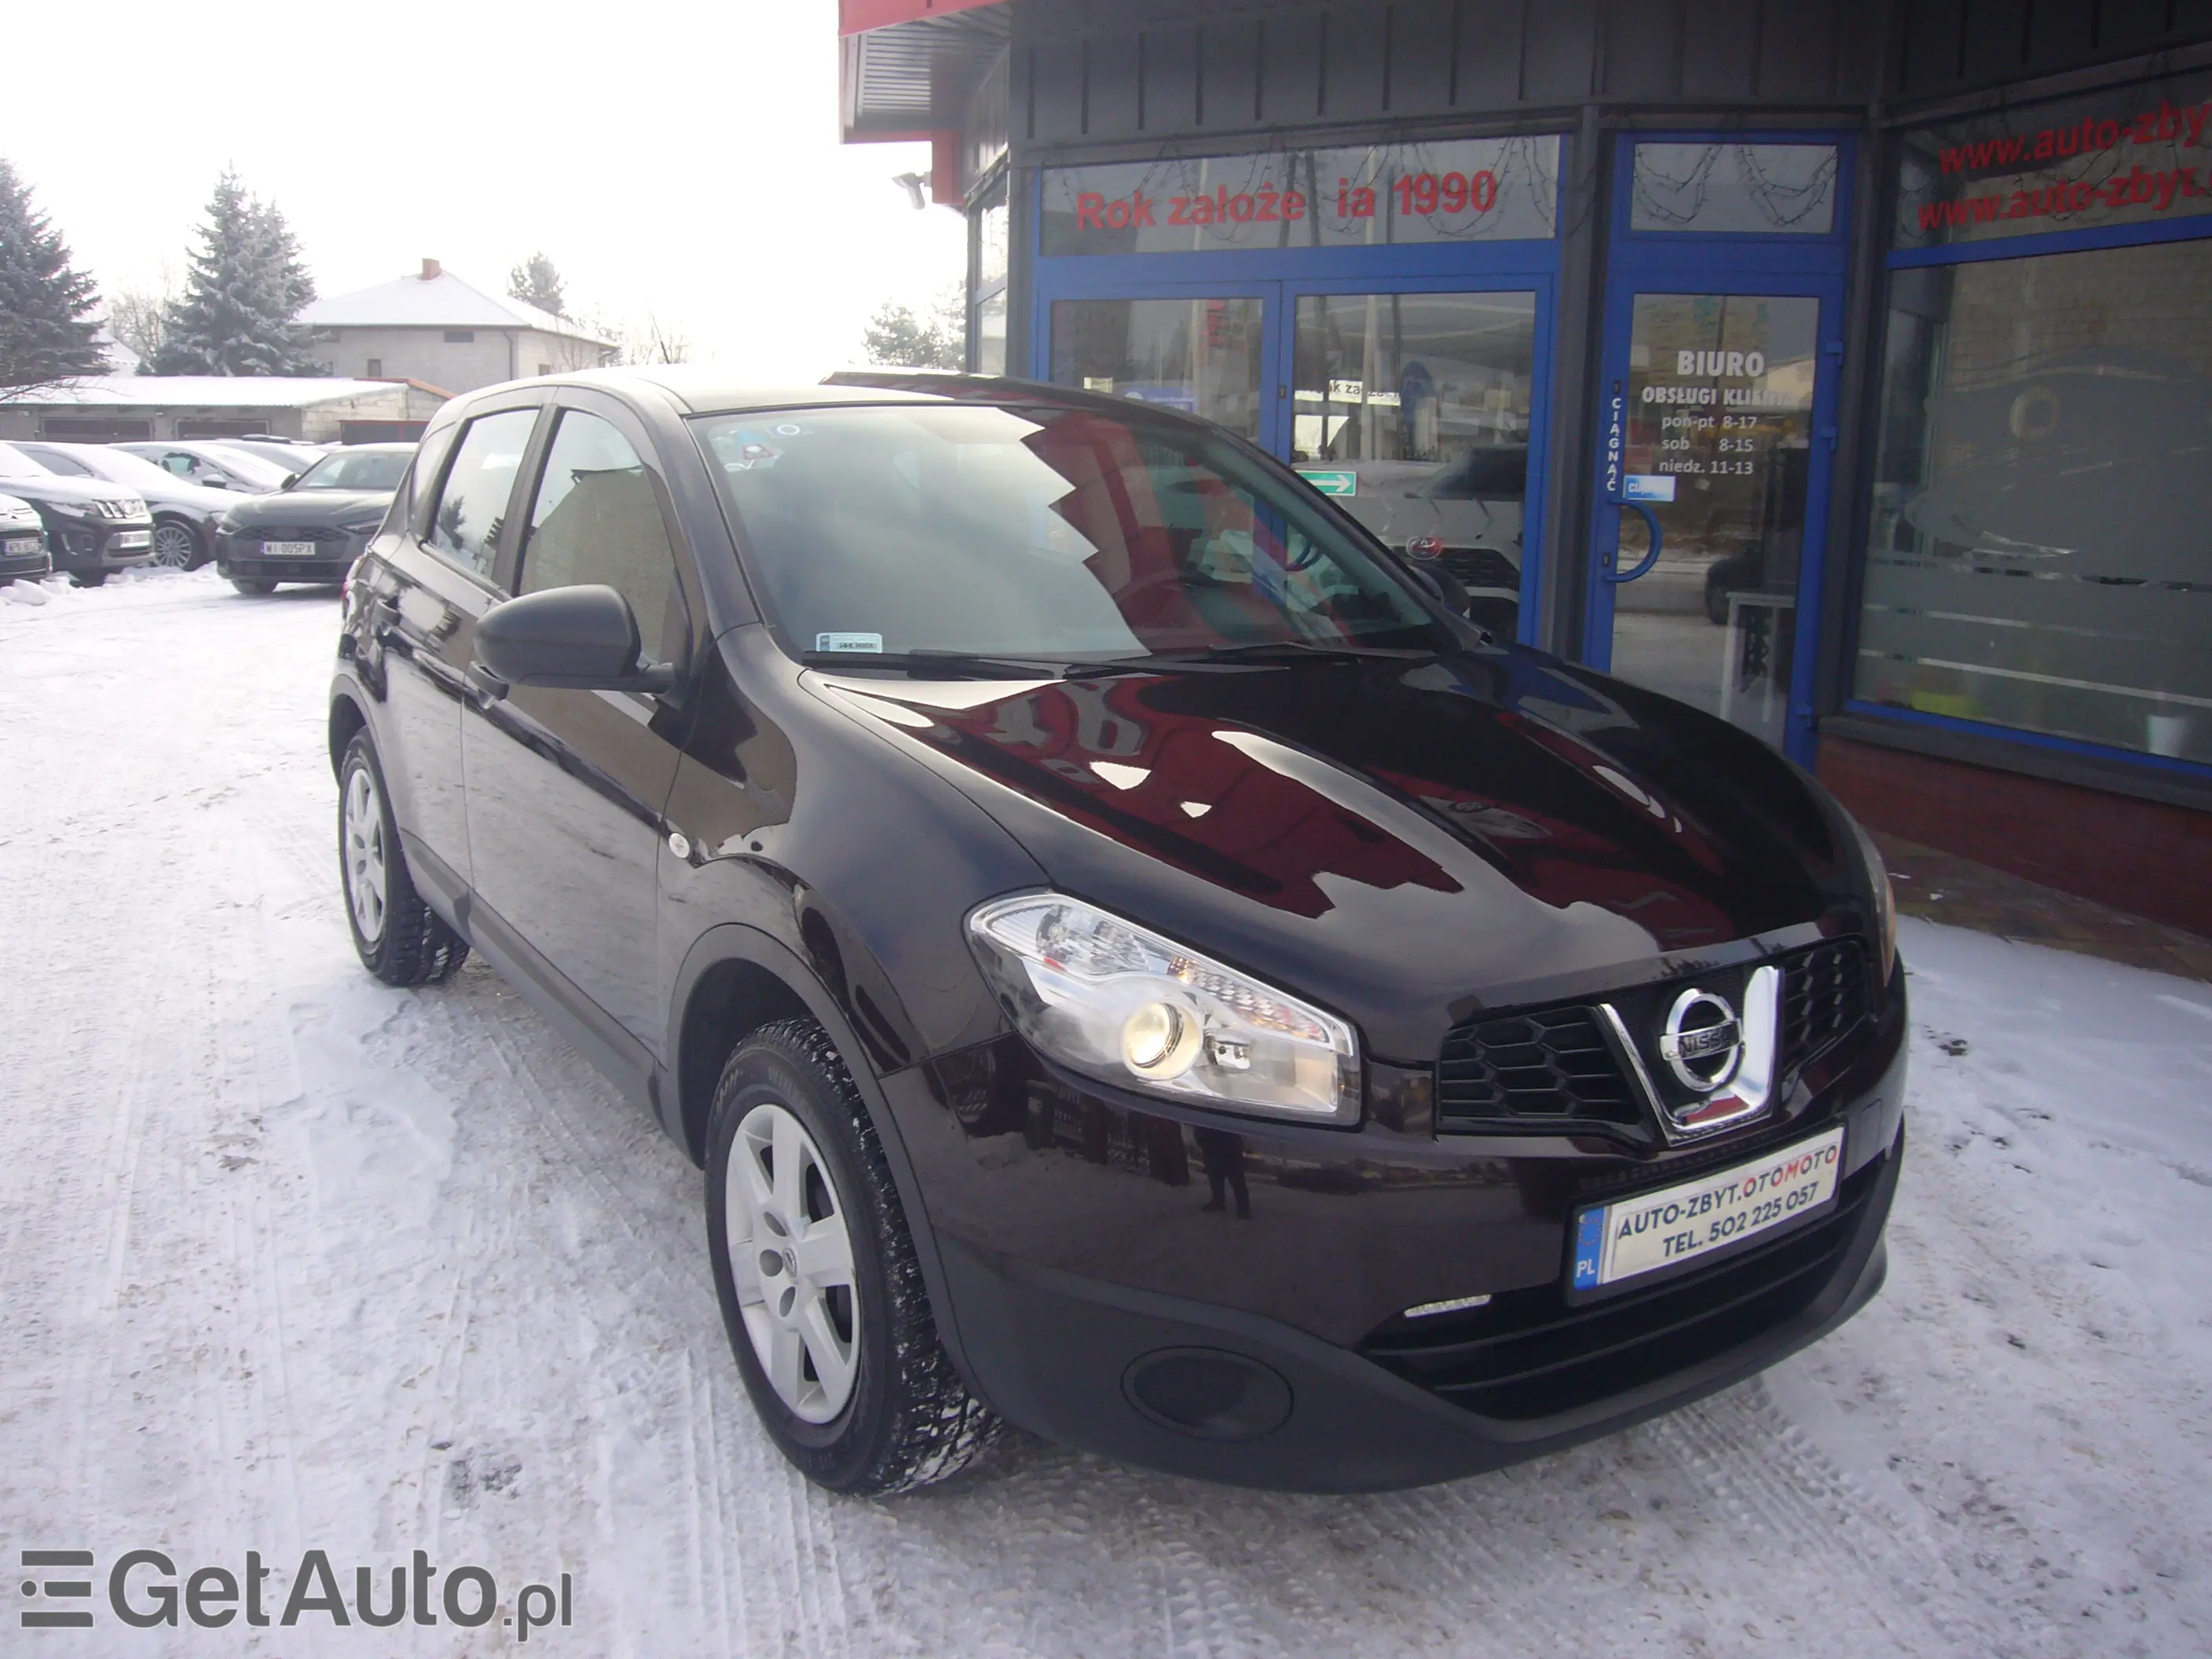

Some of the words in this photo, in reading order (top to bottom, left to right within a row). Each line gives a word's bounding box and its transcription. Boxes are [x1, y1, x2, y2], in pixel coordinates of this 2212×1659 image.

[1077, 192, 1156, 230] Rok
[1337, 178, 1375, 218] ia
[1393, 169, 1498, 216] 1990
[1917, 164, 2212, 231] www.auto-zbyt.
[1676, 350, 1765, 377] BIURO
[1641, 386, 1716, 405] OBSŁUGI
[1661, 415, 1715, 430] pon-pt
[1723, 415, 1757, 430] 8-17
[1661, 436, 1690, 450] sob
[1719, 438, 1754, 452] 8-15
[1659, 459, 1705, 474] niedz.
[1710, 460, 1754, 475] 11-13
[1663, 1229, 1704, 1257] TEL.
[1709, 1210, 1749, 1244] 502
[1750, 1197, 1782, 1227] 225
[1785, 1181, 1818, 1213] 057
[1576, 1258, 1596, 1279] PL
